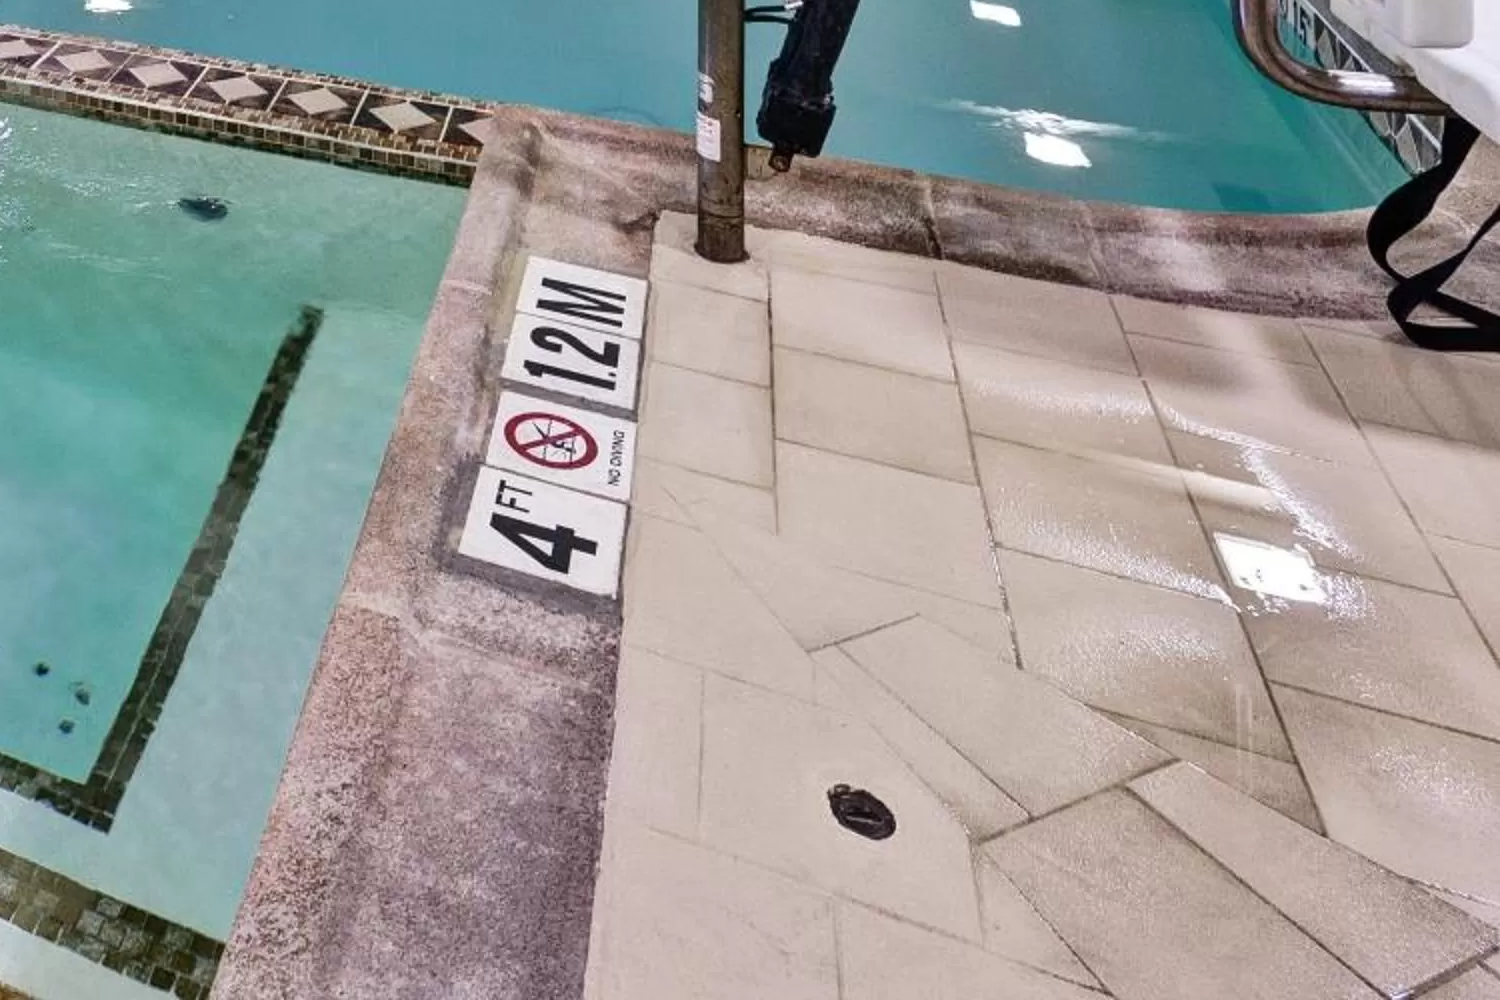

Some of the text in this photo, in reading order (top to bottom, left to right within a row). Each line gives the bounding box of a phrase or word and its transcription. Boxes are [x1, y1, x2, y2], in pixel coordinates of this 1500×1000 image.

[608, 430, 625, 486] NO DIVING
[489, 479, 599, 575] 4 FT
